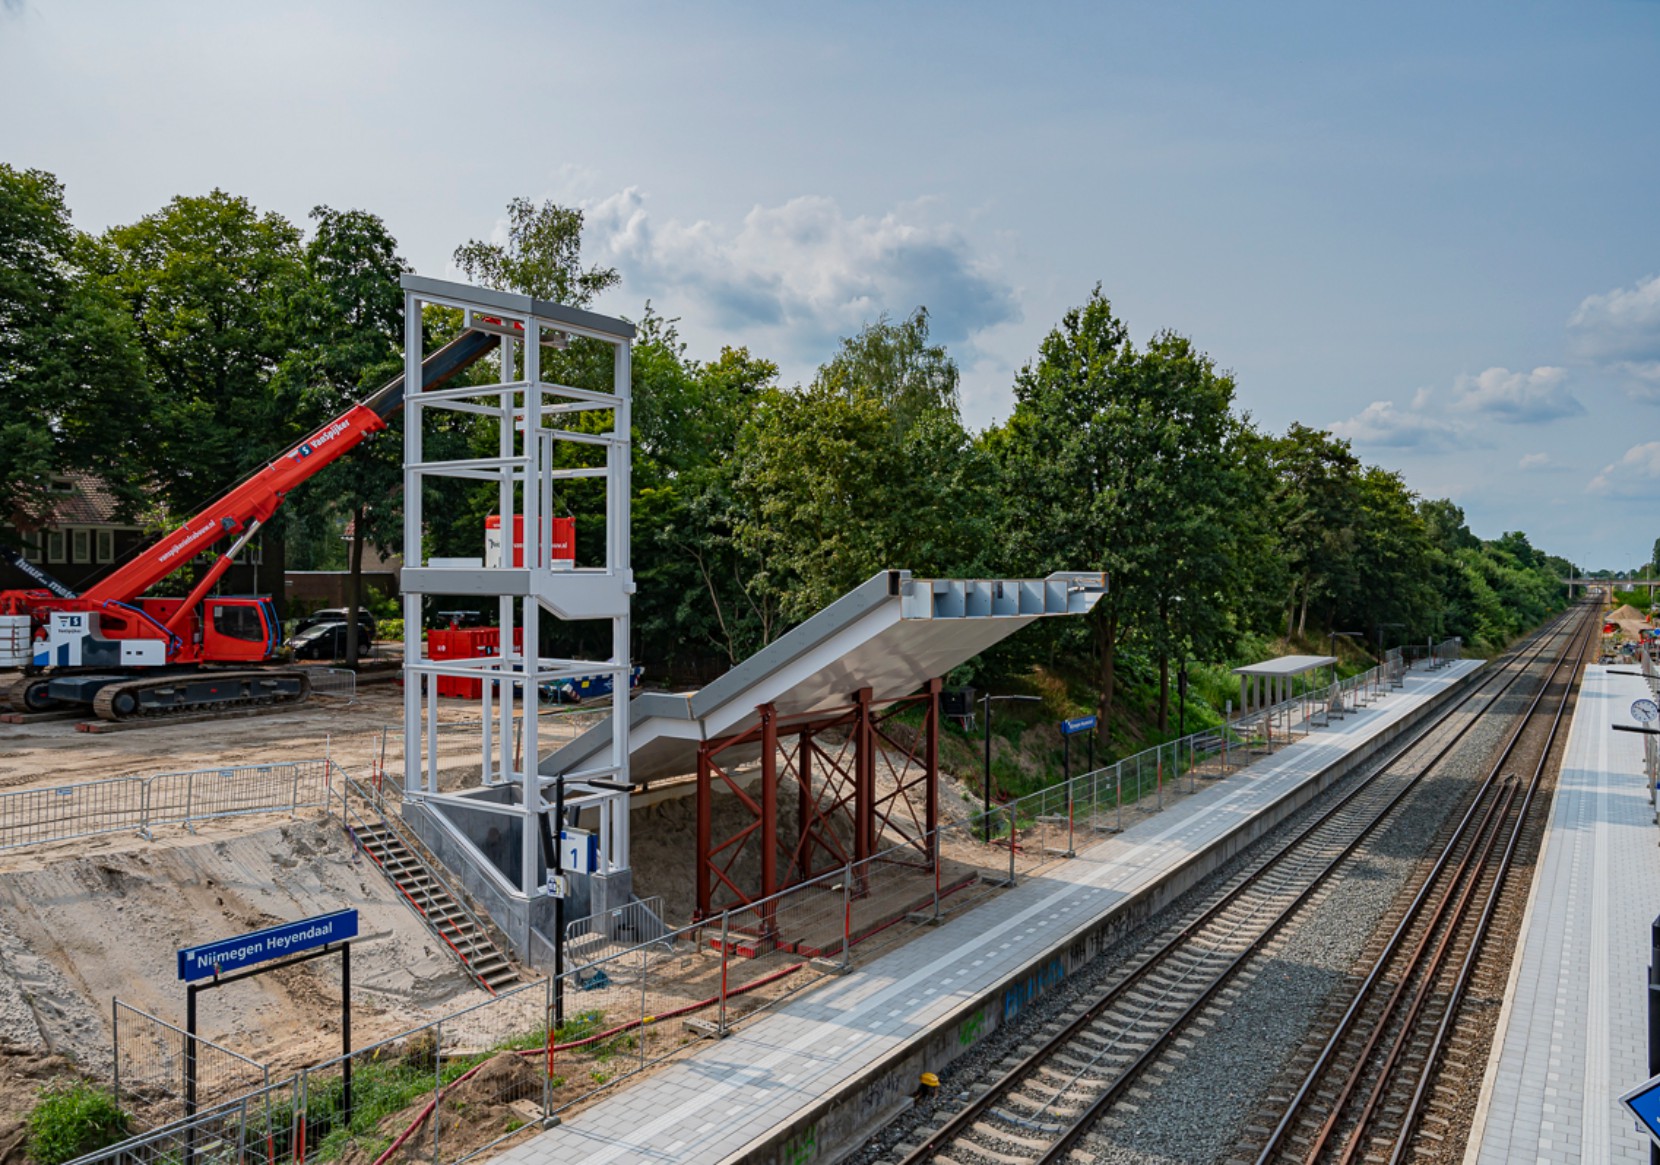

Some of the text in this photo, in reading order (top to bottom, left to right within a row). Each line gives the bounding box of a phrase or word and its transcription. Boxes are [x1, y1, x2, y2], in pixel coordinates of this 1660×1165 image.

[310, 418, 350, 449] VanSpijker
[570, 847, 578, 869] 1
[196, 921, 333, 970] Nijmegen Heyendaal
